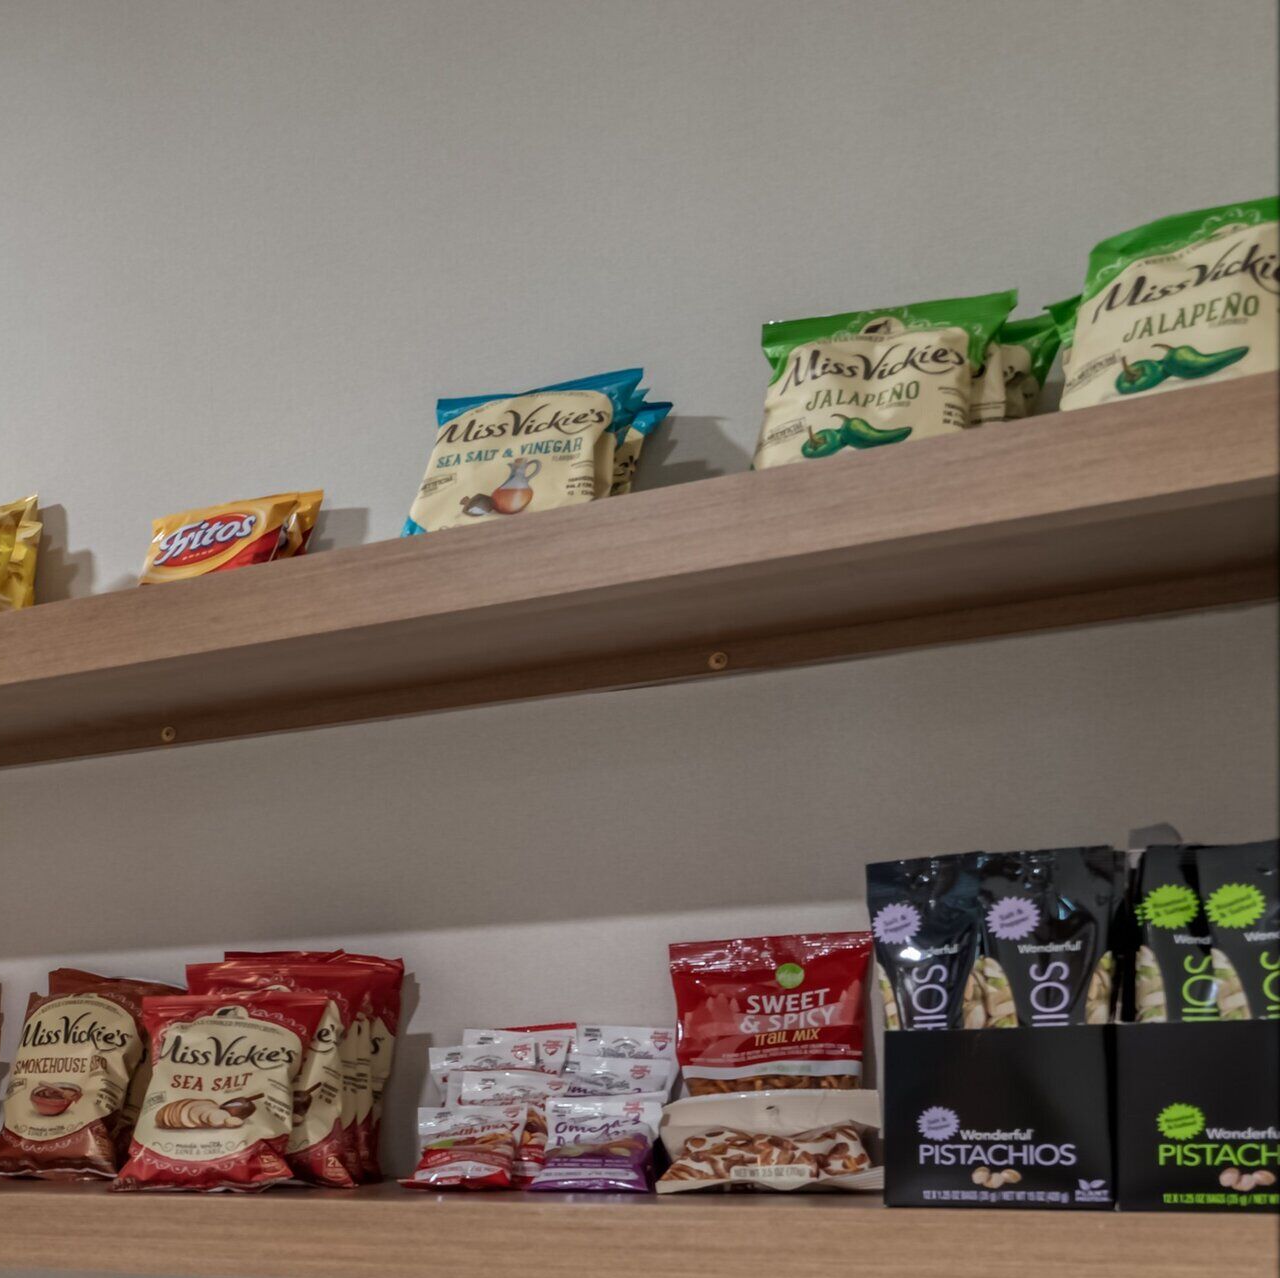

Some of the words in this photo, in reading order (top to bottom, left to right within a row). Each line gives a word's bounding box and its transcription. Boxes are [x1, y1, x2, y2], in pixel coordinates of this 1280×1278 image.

[1092, 275, 1192, 325] Miss
[1122, 292, 1260, 343] JALAPEÑO
[780, 350, 859, 397] Miss
[435, 420, 507, 445] Miss
[505, 403, 608, 437] Vickie's
[436, 454, 461, 469] SEA
[465, 449, 500, 463] SALT
[502, 448, 514, 458] &
[520, 437, 583, 455] VINEGAR
[153, 515, 258, 568] Fritos
[1017, 941, 1082, 954] Wonderful
[747, 988, 831, 1014] SWEET
[19, 1019, 60, 1048] Miss
[60, 1011, 132, 1051] Vickie's
[740, 1014, 760, 1035] &
[768, 1005, 837, 1032] SPICY
[792, 1027, 821, 1042] MIX
[14, 1056, 86, 1075] SMOKEHOUSE
[158, 1033, 210, 1066] Miss
[208, 1035, 298, 1071] Vickie's
[171, 1074, 203, 1092] SEA
[211, 1072, 253, 1091] SALT
[960, 1129, 1033, 1141] Wonderful
[1206, 1127, 1280, 1140] Wonderfu
[918, 1143, 1077, 1166] PISTACHIOS
